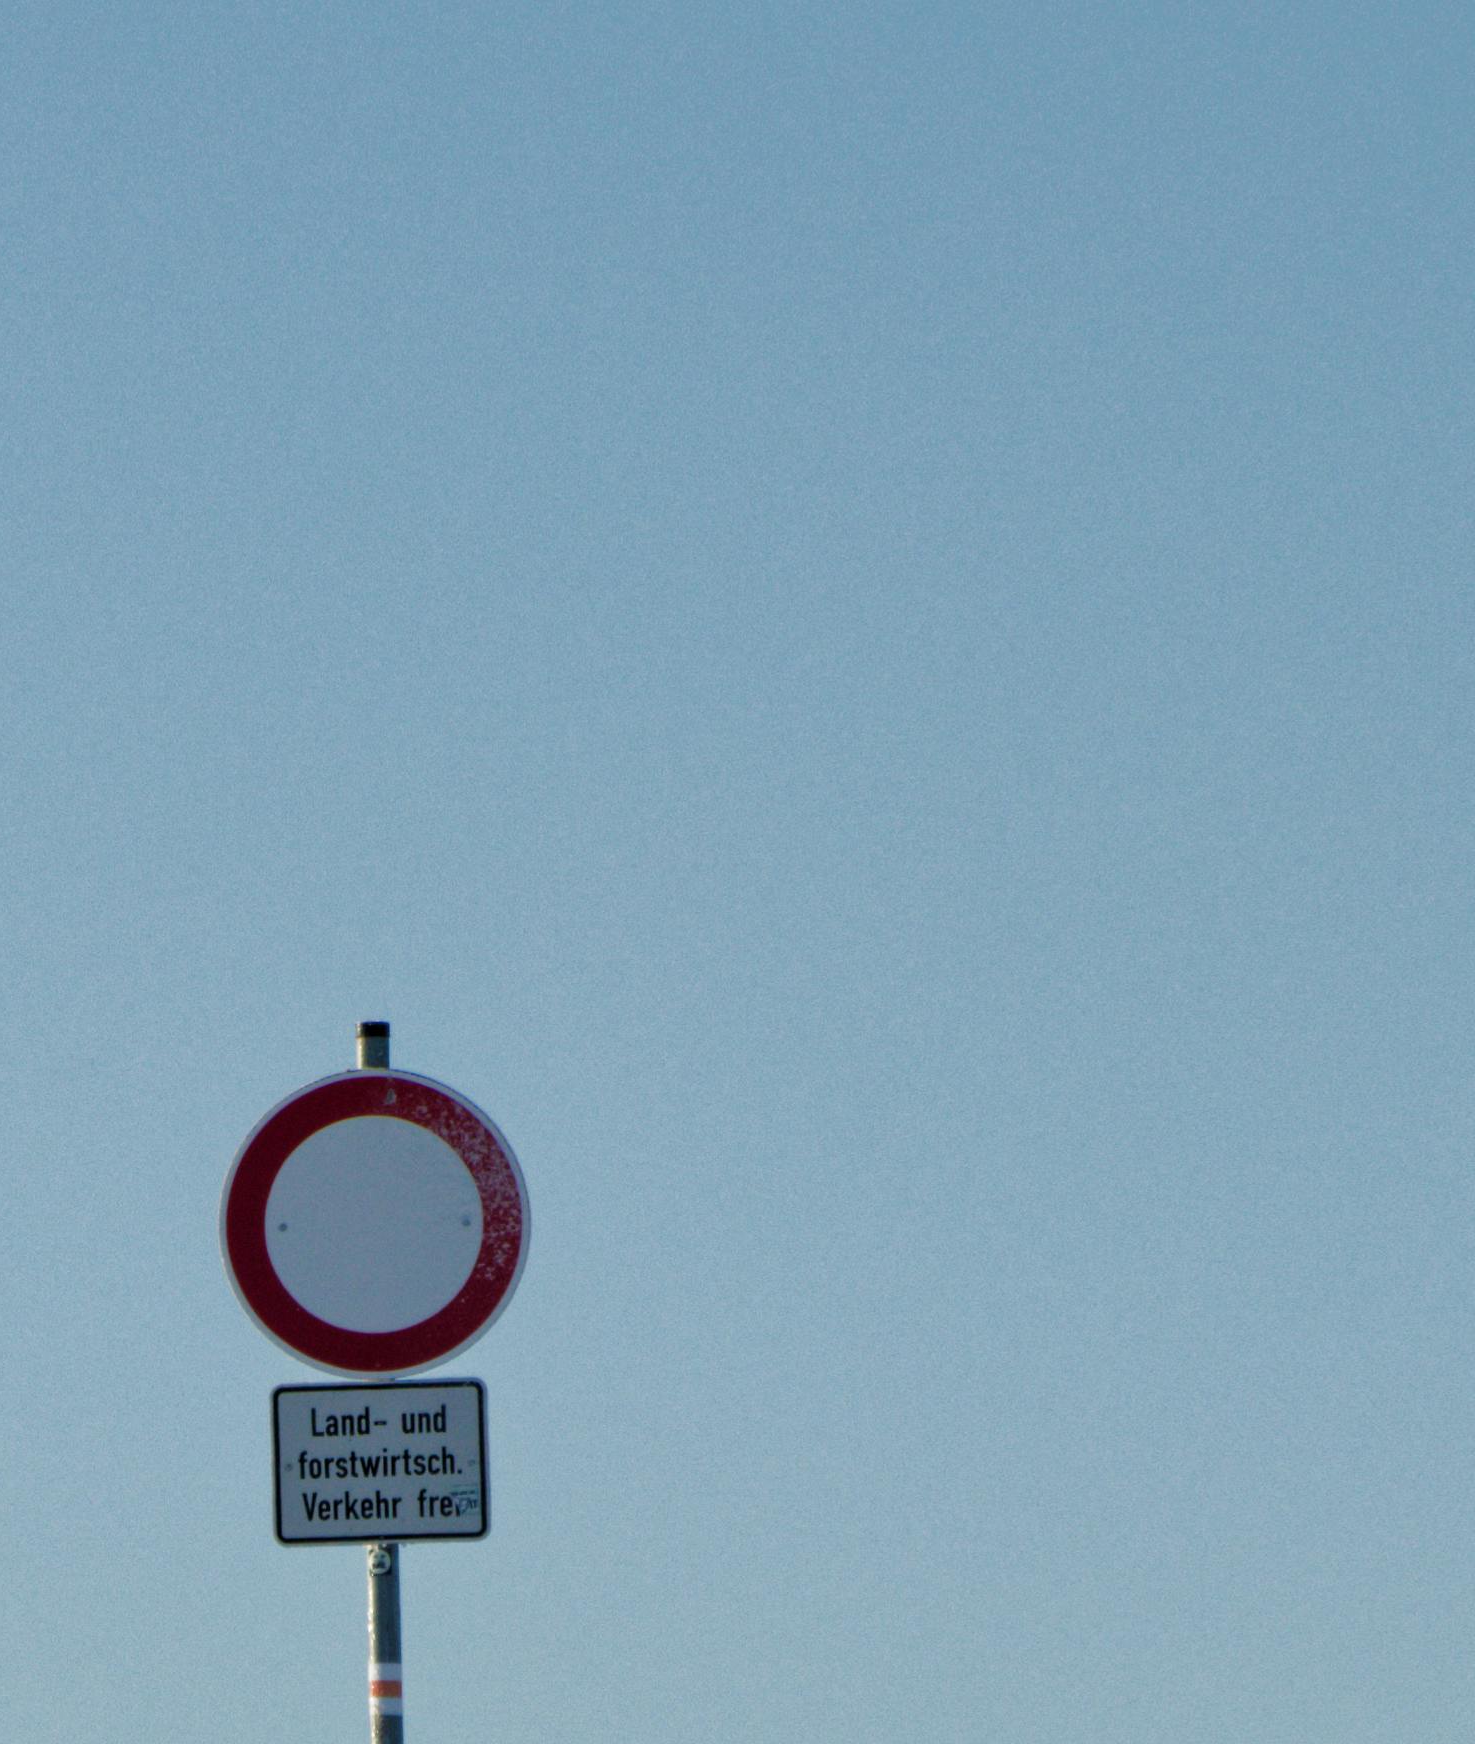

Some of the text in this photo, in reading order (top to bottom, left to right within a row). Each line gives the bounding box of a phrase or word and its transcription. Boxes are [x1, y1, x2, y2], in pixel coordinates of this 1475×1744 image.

[310, 1403, 447, 1438] Land- und
[297, 1446, 463, 1480] forstwirtsch.
[301, 1489, 402, 1522] Verkehr
